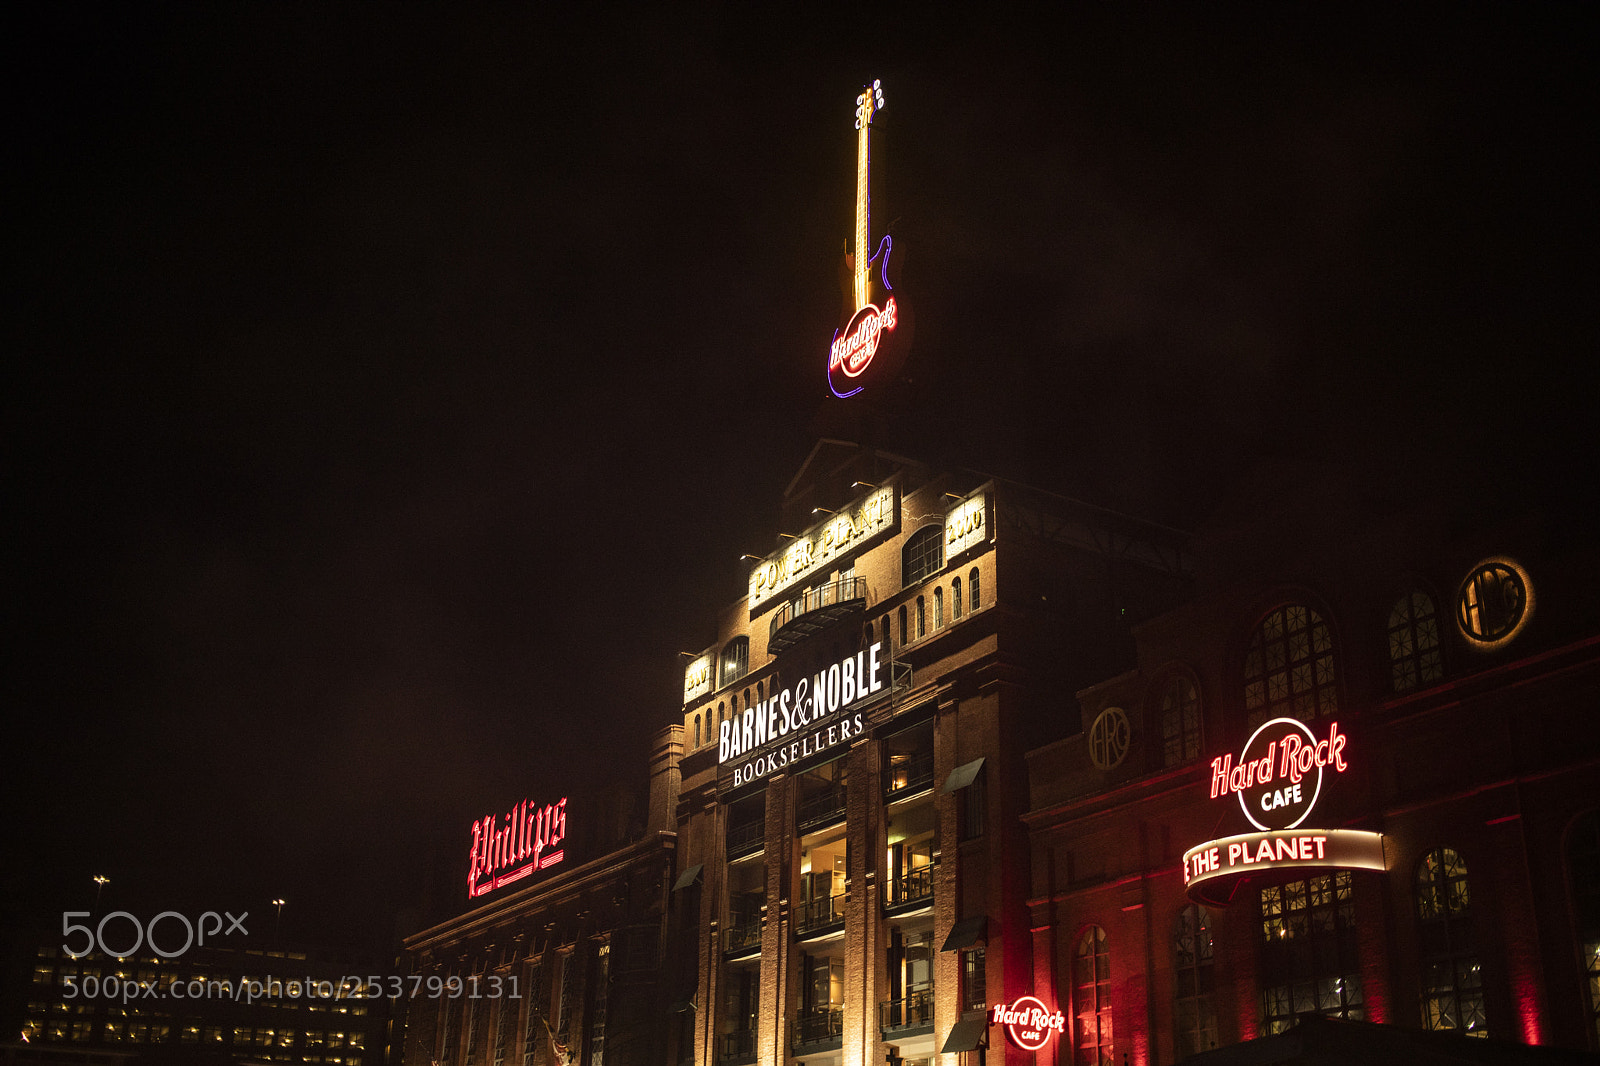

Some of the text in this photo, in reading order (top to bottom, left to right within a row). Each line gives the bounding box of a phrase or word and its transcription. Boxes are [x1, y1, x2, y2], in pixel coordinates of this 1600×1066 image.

[830, 298, 897, 369] Hard Rock
[755, 494, 888, 599] POWER PLANT
[734, 713, 864, 787] BOOKSELLERS
[1210, 721, 1347, 799] Hard Rock
[1261, 784, 1303, 811] CAFE
[467, 796, 567, 899] Phillips
[1192, 847, 1220, 876] THE
[1228, 836, 1327, 867] PLANET
[993, 1004, 1065, 1033] Hard Rock
[1021, 1030, 1040, 1041] CAFE
